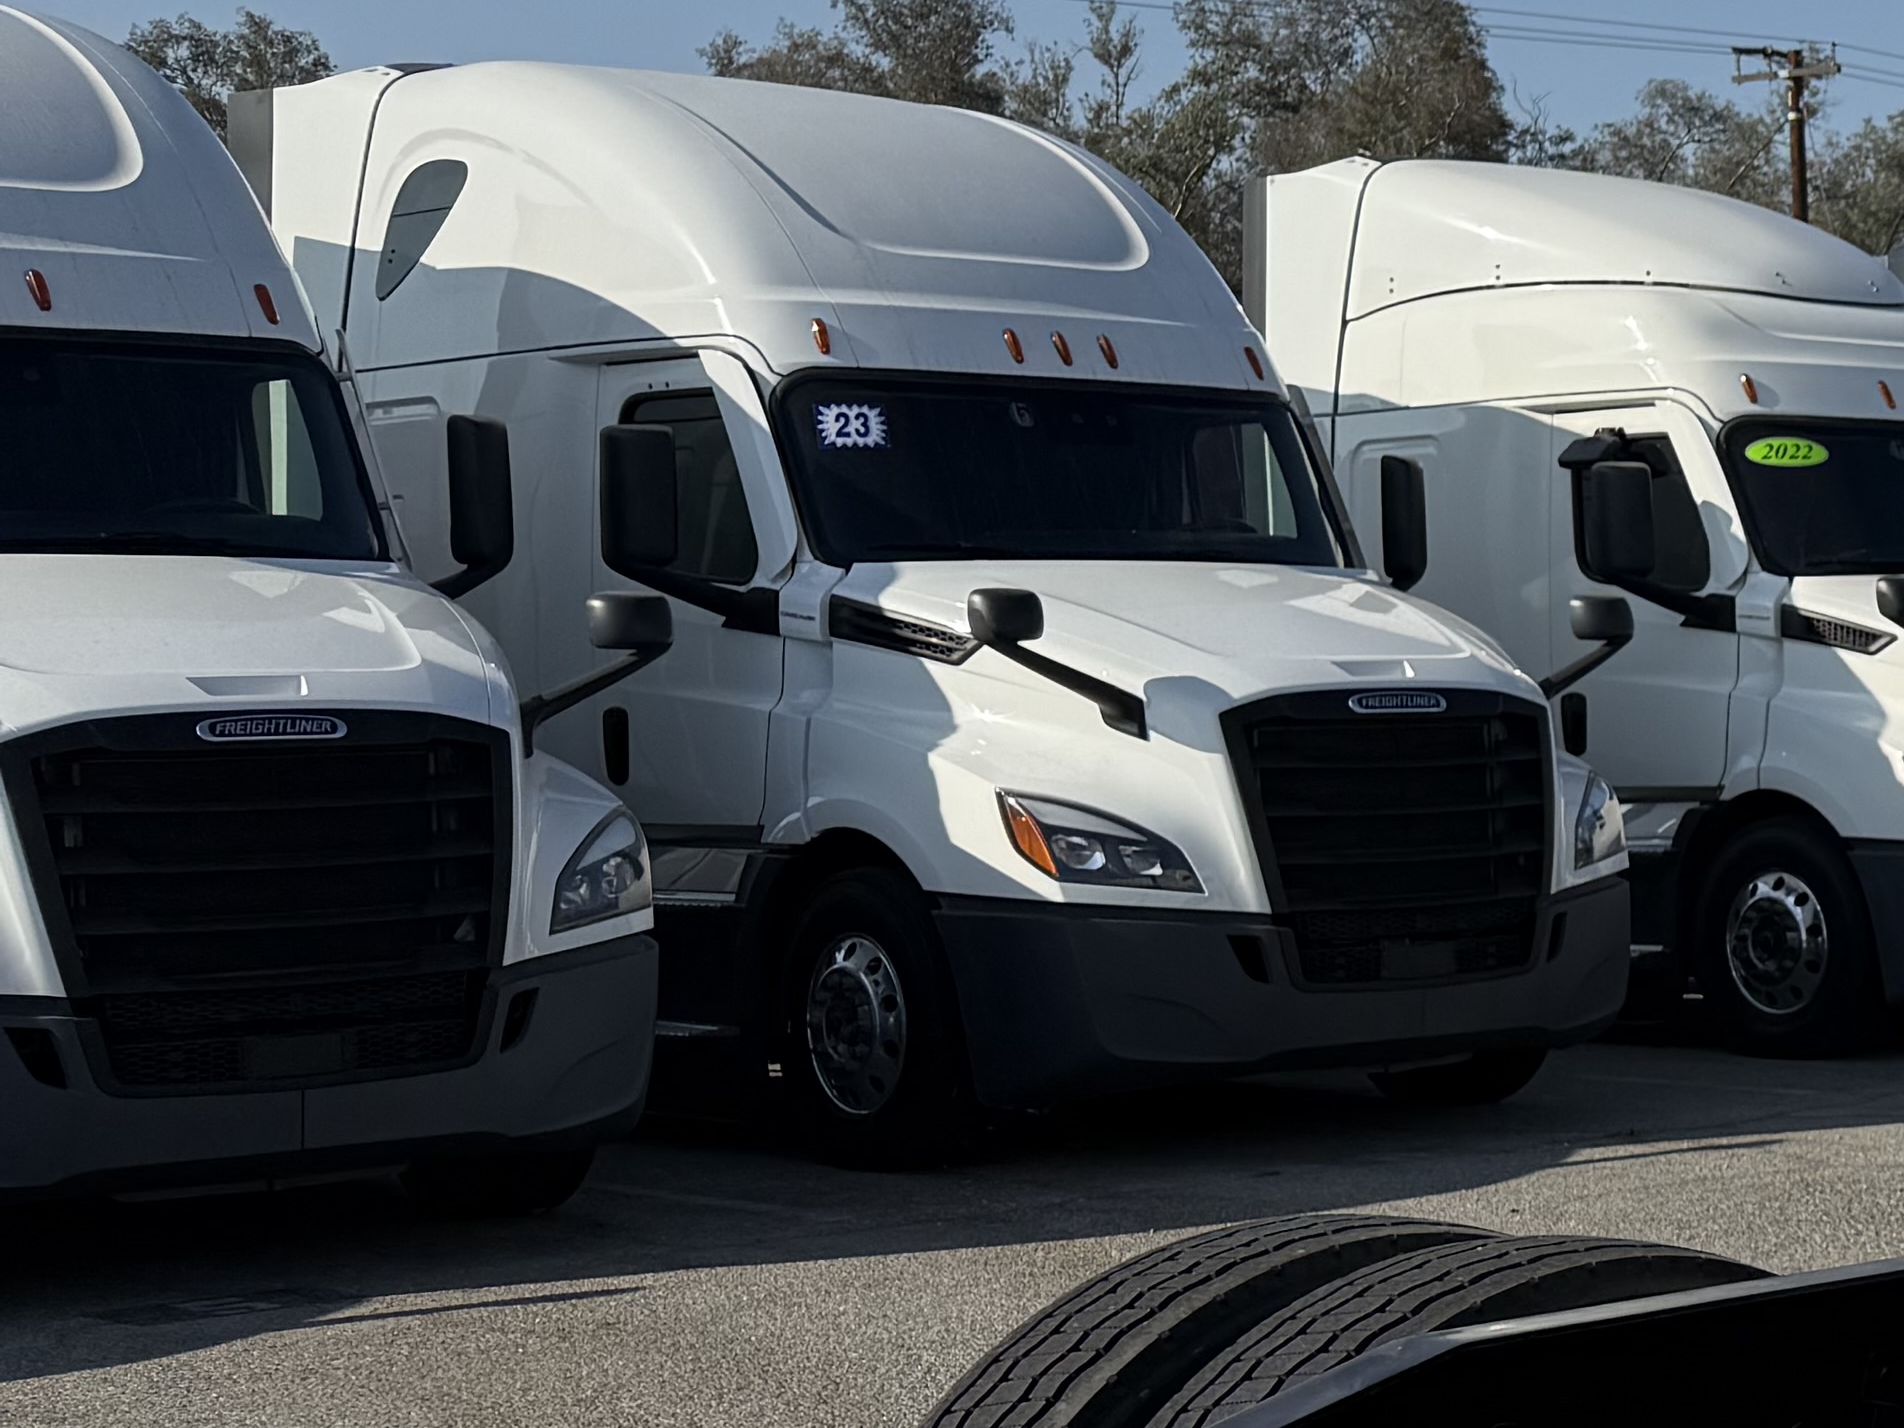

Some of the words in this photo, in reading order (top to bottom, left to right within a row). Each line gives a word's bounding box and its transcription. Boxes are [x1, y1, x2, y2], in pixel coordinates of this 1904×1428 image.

[834, 411, 871, 438] 23
[1761, 442, 1814, 460] 2022
[214, 718, 332, 736] FREIGHTLINER
